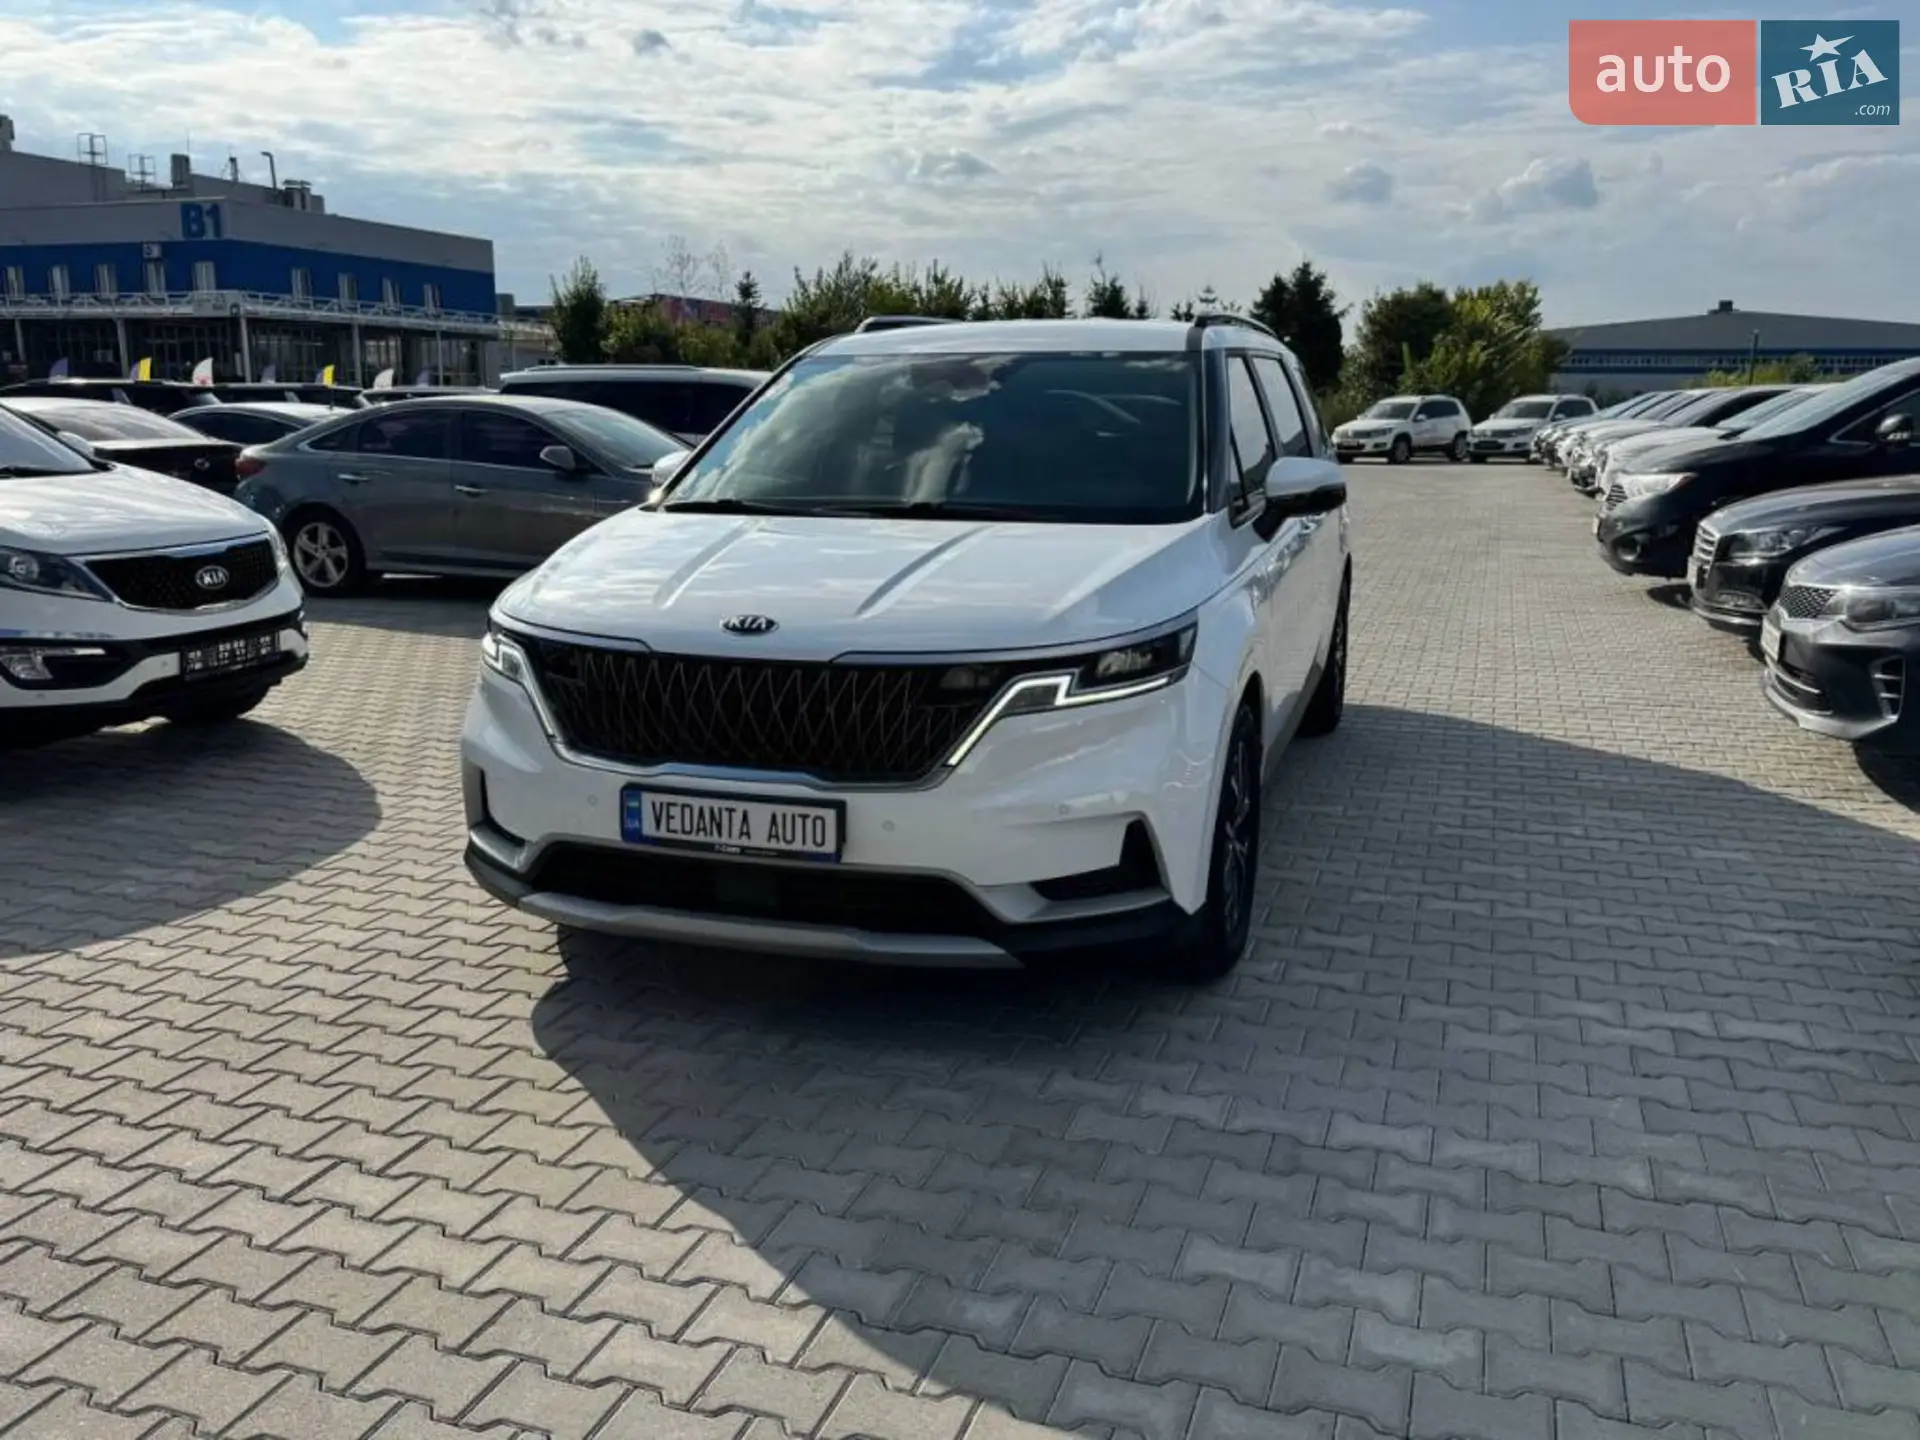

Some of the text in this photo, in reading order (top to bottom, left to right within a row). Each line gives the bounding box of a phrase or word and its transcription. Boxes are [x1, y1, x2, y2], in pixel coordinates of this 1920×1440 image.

[181, 203, 221, 238] B1
[202, 570, 226, 585] KIA
[728, 616, 766, 629] KIA
[651, 801, 826, 847] VEDANTA AUTO
